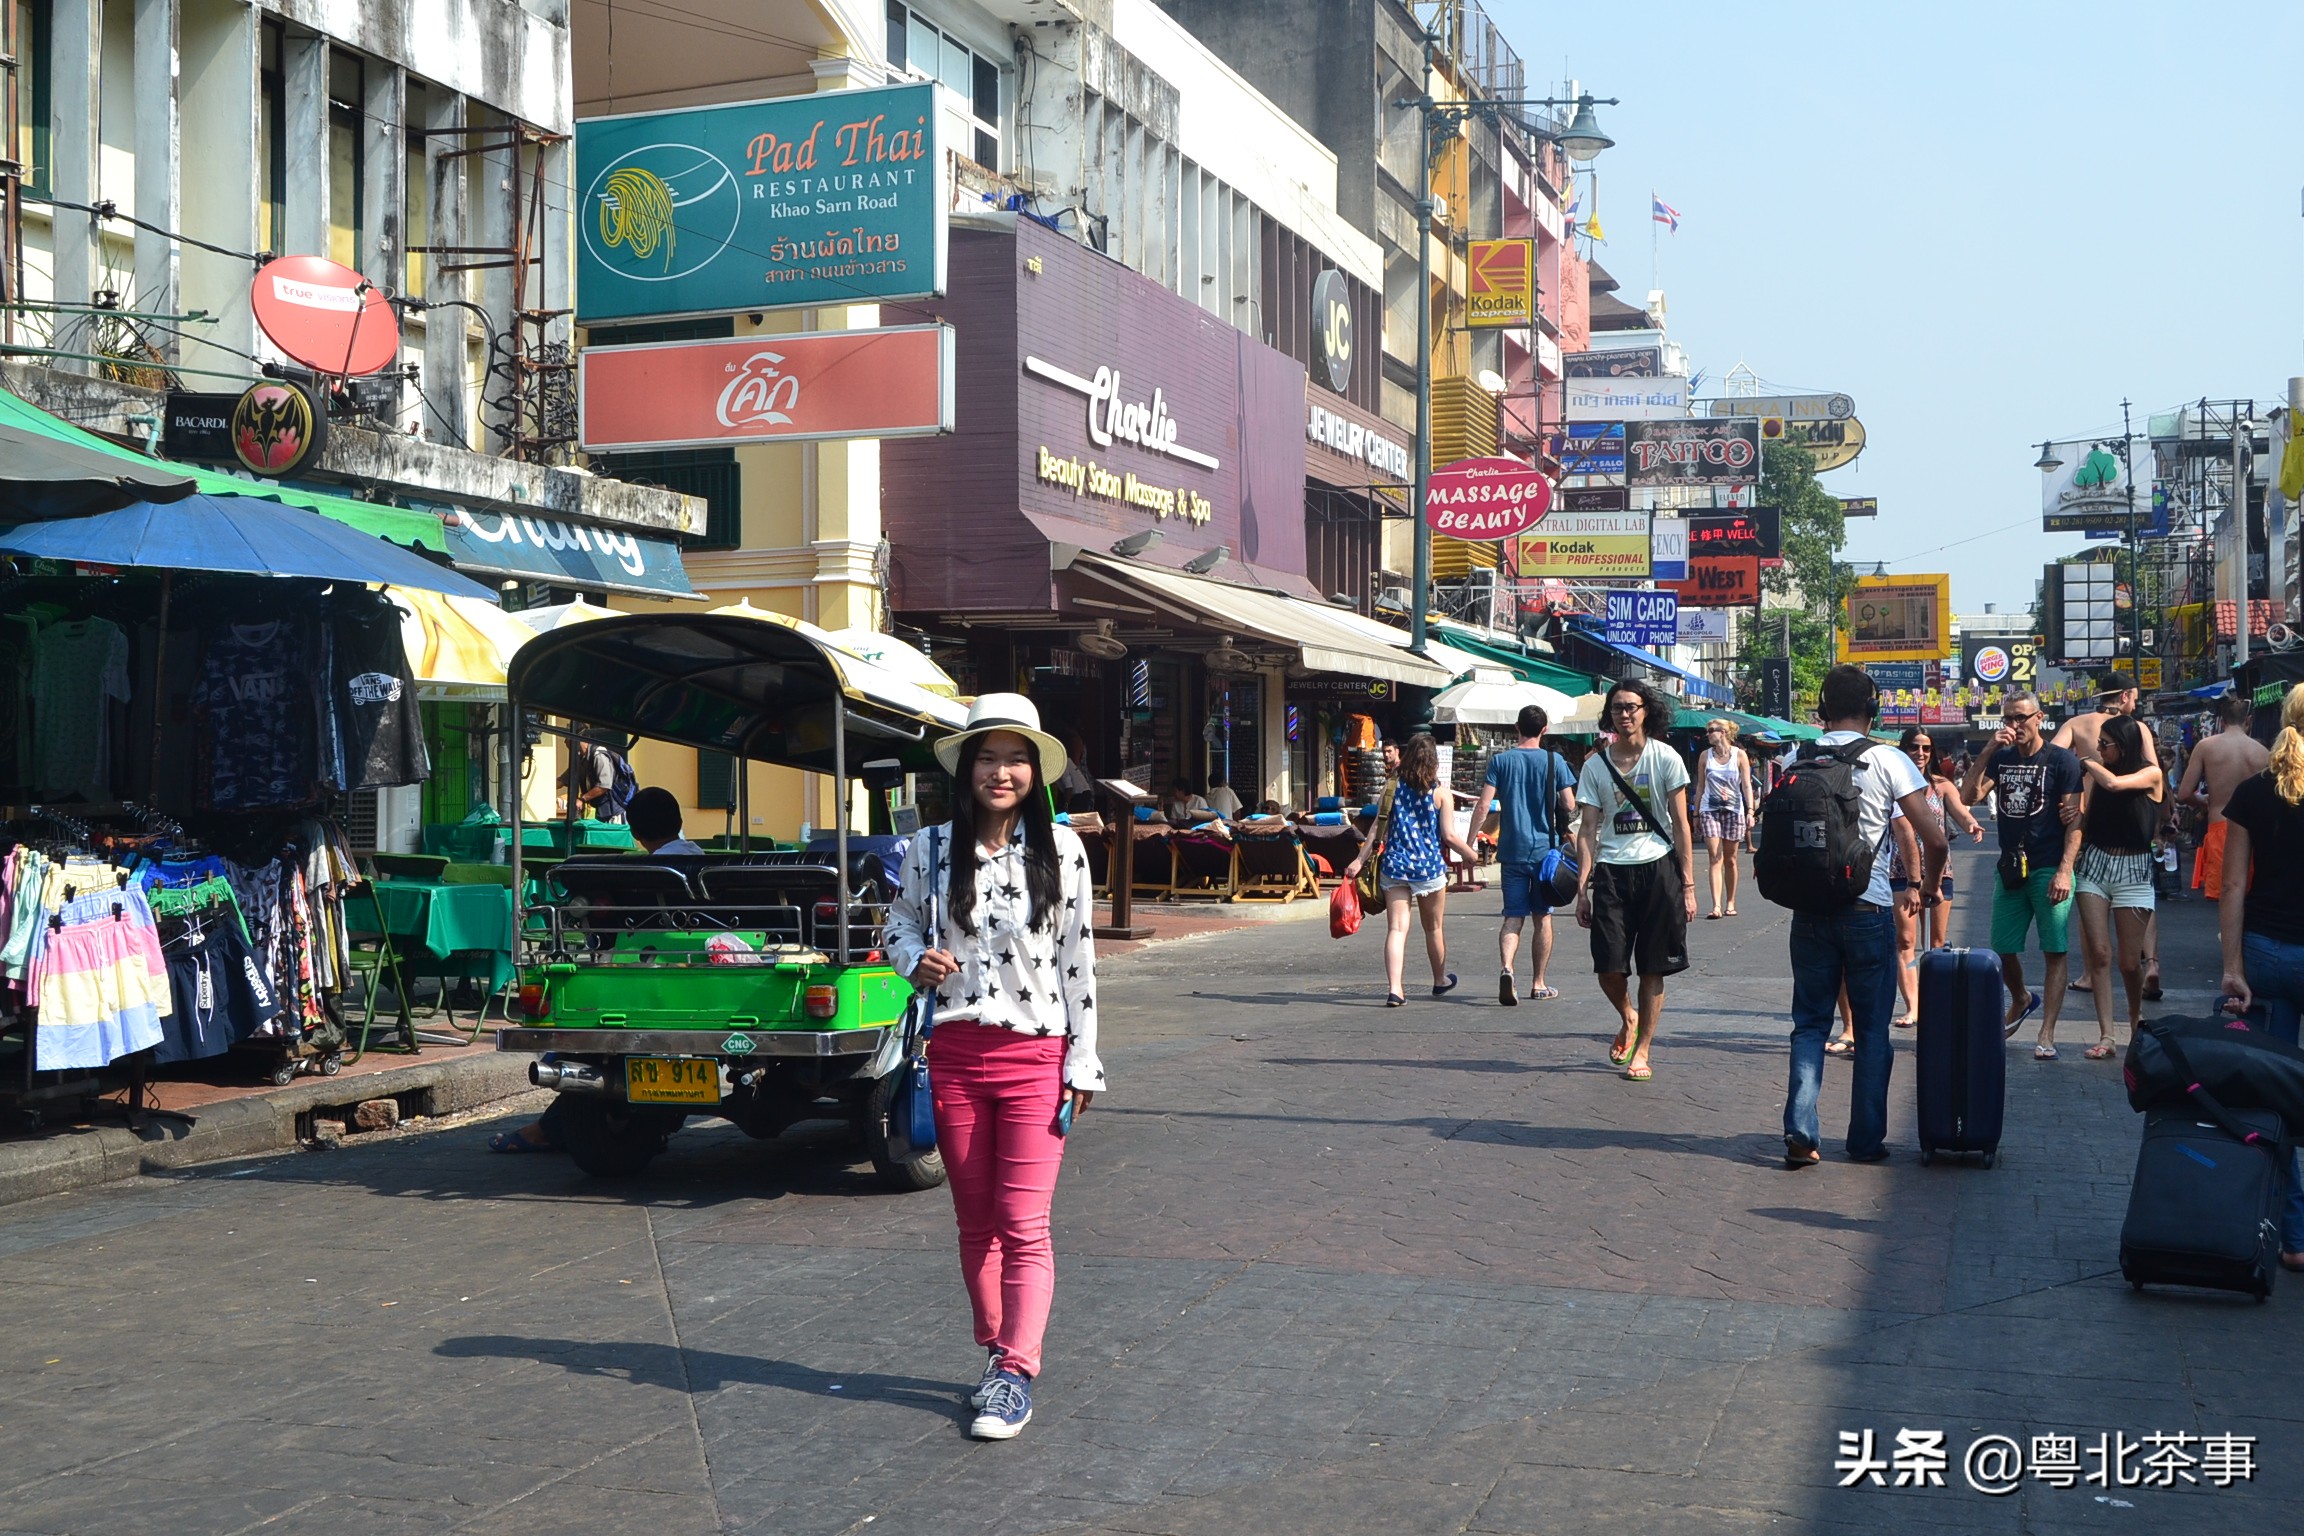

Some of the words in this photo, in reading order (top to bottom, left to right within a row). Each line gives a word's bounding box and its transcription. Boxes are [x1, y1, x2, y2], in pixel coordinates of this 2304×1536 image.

[745, 120, 825, 176] Pad
[835, 114, 926, 167] Thai
[753, 169, 915, 199] RESTAURANT
[770, 202, 810, 219] Khao
[815, 199, 851, 214] Sarn
[857, 192, 898, 210] Road
[770, 227, 899, 261] ร้านผัดไทย
[282, 284, 313, 299] true
[317, 292, 356, 304] visions
[1471, 294, 1526, 310] Kodak
[1471, 309, 1527, 318] express
[1325, 300, 1350, 361] JC
[175, 416, 227, 428] BACARDI
[1308, 405, 1365, 458] JEWELRY
[1364, 429, 1408, 480] CENTER
[1630, 437, 1755, 471] TATTOO
[1465, 466, 1499, 479] Charlie
[1660, 476, 1707, 484] TATTOO
[1711, 475, 1755, 483] GROUP
[1039, 445, 1086, 496] Beauty
[1088, 460, 1122, 499] Salon
[1125, 471, 1174, 519] Massage
[1177, 488, 1188, 516] &
[1190, 489, 1211, 527] Spa
[1425, 482, 1538, 506] MASSAGE
[1437, 503, 1527, 530] BEAUTY
[1576, 518, 1621, 532] DIGITAL
[1625, 518, 1646, 531] LAB
[1550, 541, 1595, 554] Kodak
[1566, 553, 1644, 565] PROFESSIONAL
[1698, 564, 1746, 589] WEST
[1607, 596, 1632, 620] SIM
[1637, 596, 1676, 621] CARD
[1606, 631, 1637, 643] UNLOCK
[1649, 631, 1675, 644] PHONE
[1980, 653, 2003, 664] BURGER
[1980, 659, 2004, 673] KING
[360, 673, 382, 685] VANS
[1288, 681, 1329, 689] JEWELRY
[1331, 682, 1368, 690] CENTER
[364, 685, 380, 697] THE
[2038, 720, 2056, 730] NG
[728, 1040, 750, 1049] CNG
[672, 1060, 708, 1084] 914
